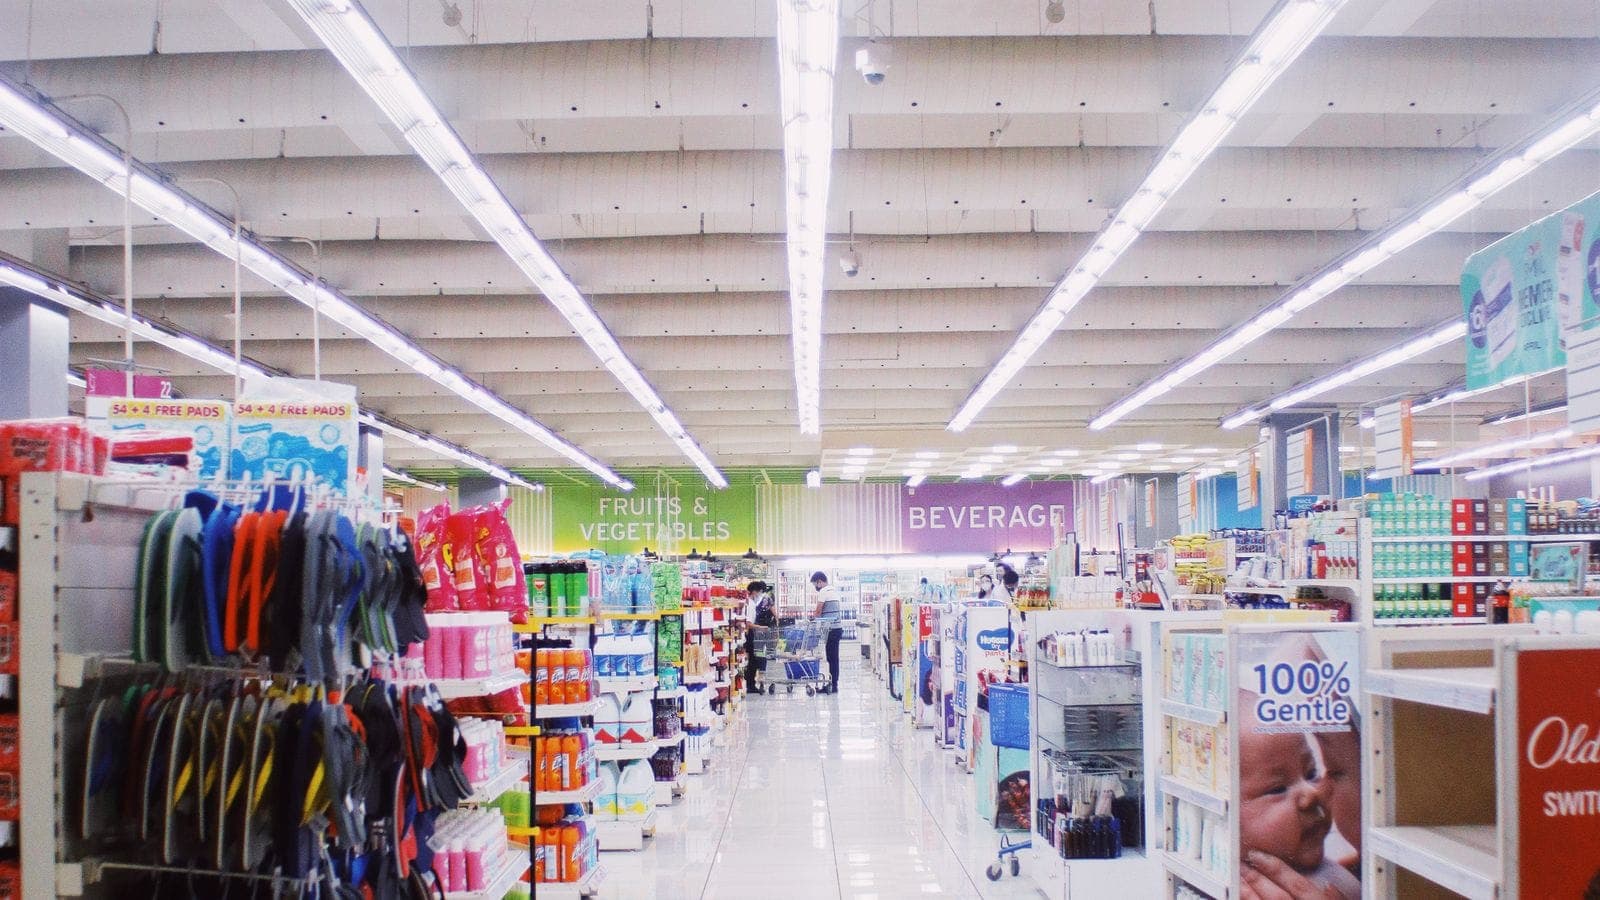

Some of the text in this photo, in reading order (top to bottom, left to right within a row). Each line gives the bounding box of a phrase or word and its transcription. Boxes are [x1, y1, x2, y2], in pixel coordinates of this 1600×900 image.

[160, 380, 171, 399] 22
[112, 404, 127, 415] 54
[142, 404, 151, 414] 4
[155, 405, 182, 416] FREE
[187, 406, 220, 417] PADS
[237, 404, 252, 414] 54
[267, 404, 276, 414] 4
[280, 405, 308, 415] FREE
[313, 405, 346, 416] PADS
[599, 497, 708, 516] FRUITS &
[580, 522, 731, 542] VEGETABLES
[1253, 661, 1351, 695] 100%
[1256, 697, 1348, 722] Gentle
[1543, 790, 1600, 817] SWIT
